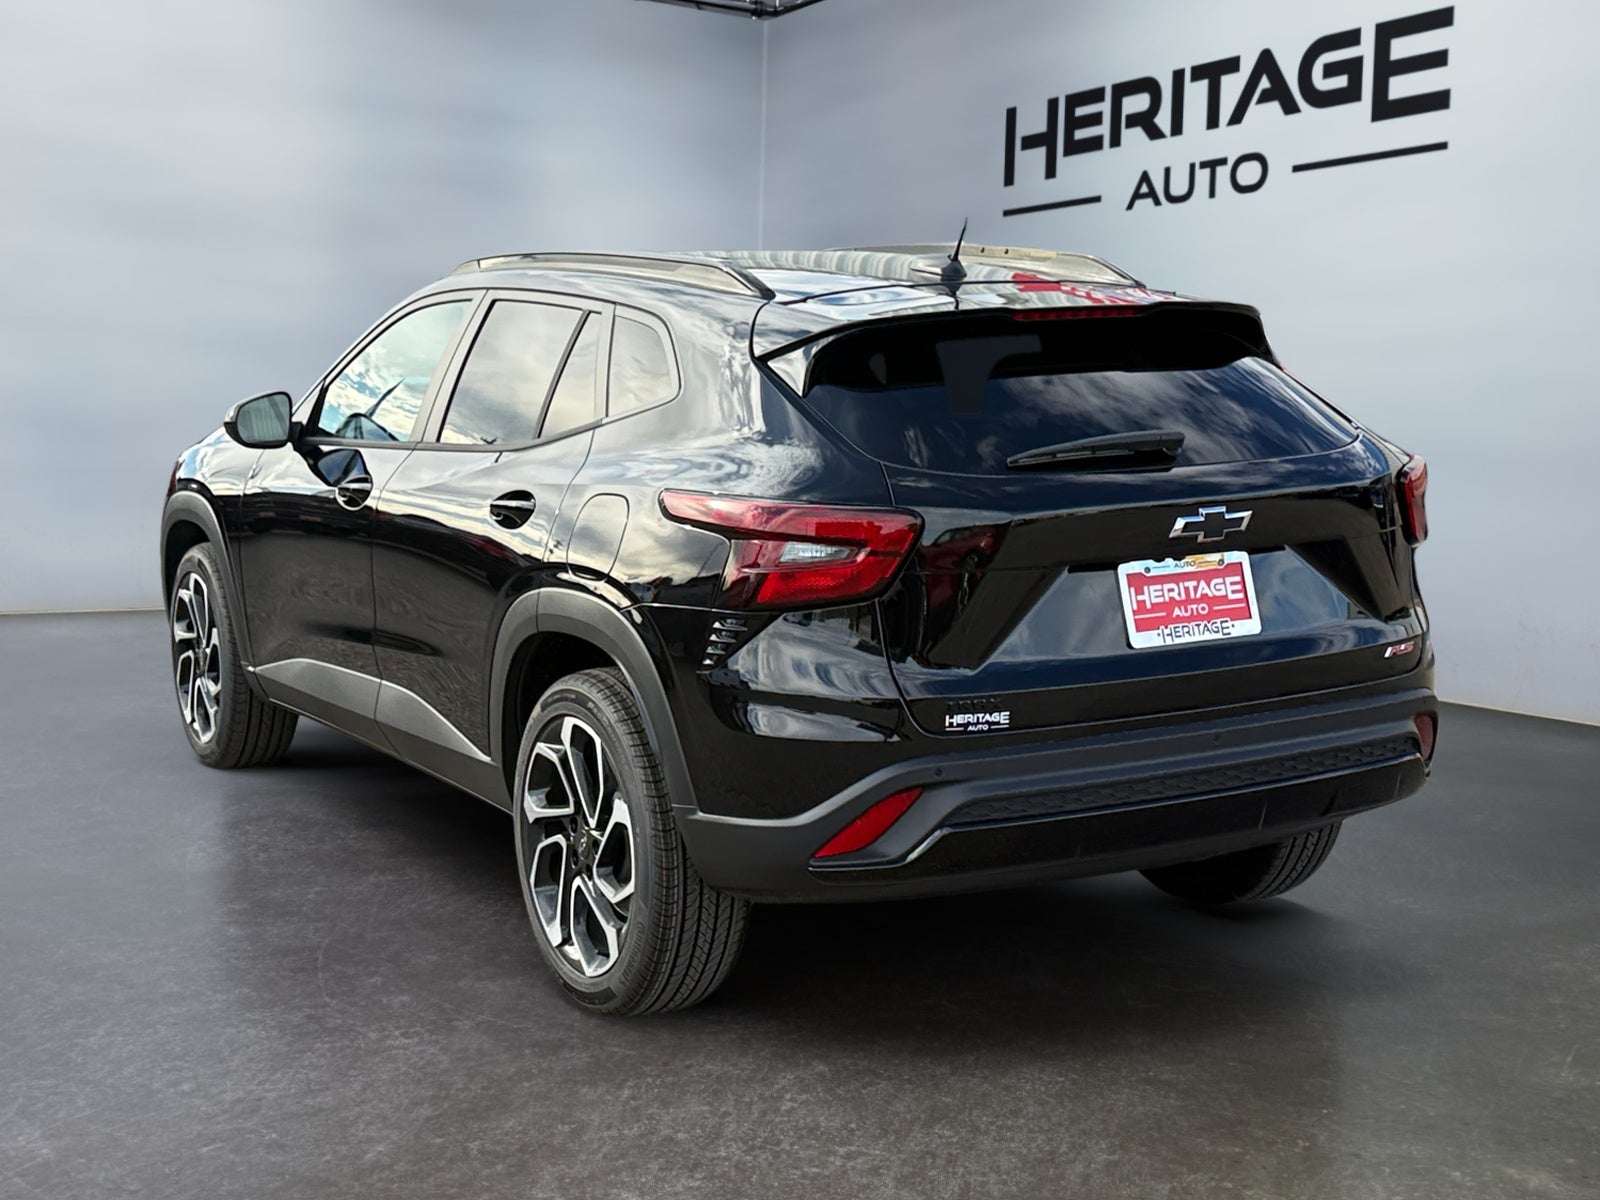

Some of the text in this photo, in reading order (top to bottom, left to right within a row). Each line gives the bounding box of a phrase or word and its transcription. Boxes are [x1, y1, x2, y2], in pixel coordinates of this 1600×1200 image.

[1003, 5, 1455, 188] HERITAGE
[1125, 151, 1269, 211] AUTO
[1173, 560, 1196, 569] AUTO
[1130, 576, 1244, 610] HERITAGE
[1172, 603, 1209, 618] AUTO
[1161, 620, 1231, 643] HERITAGE
[945, 711, 1010, 727] HERITAGE
